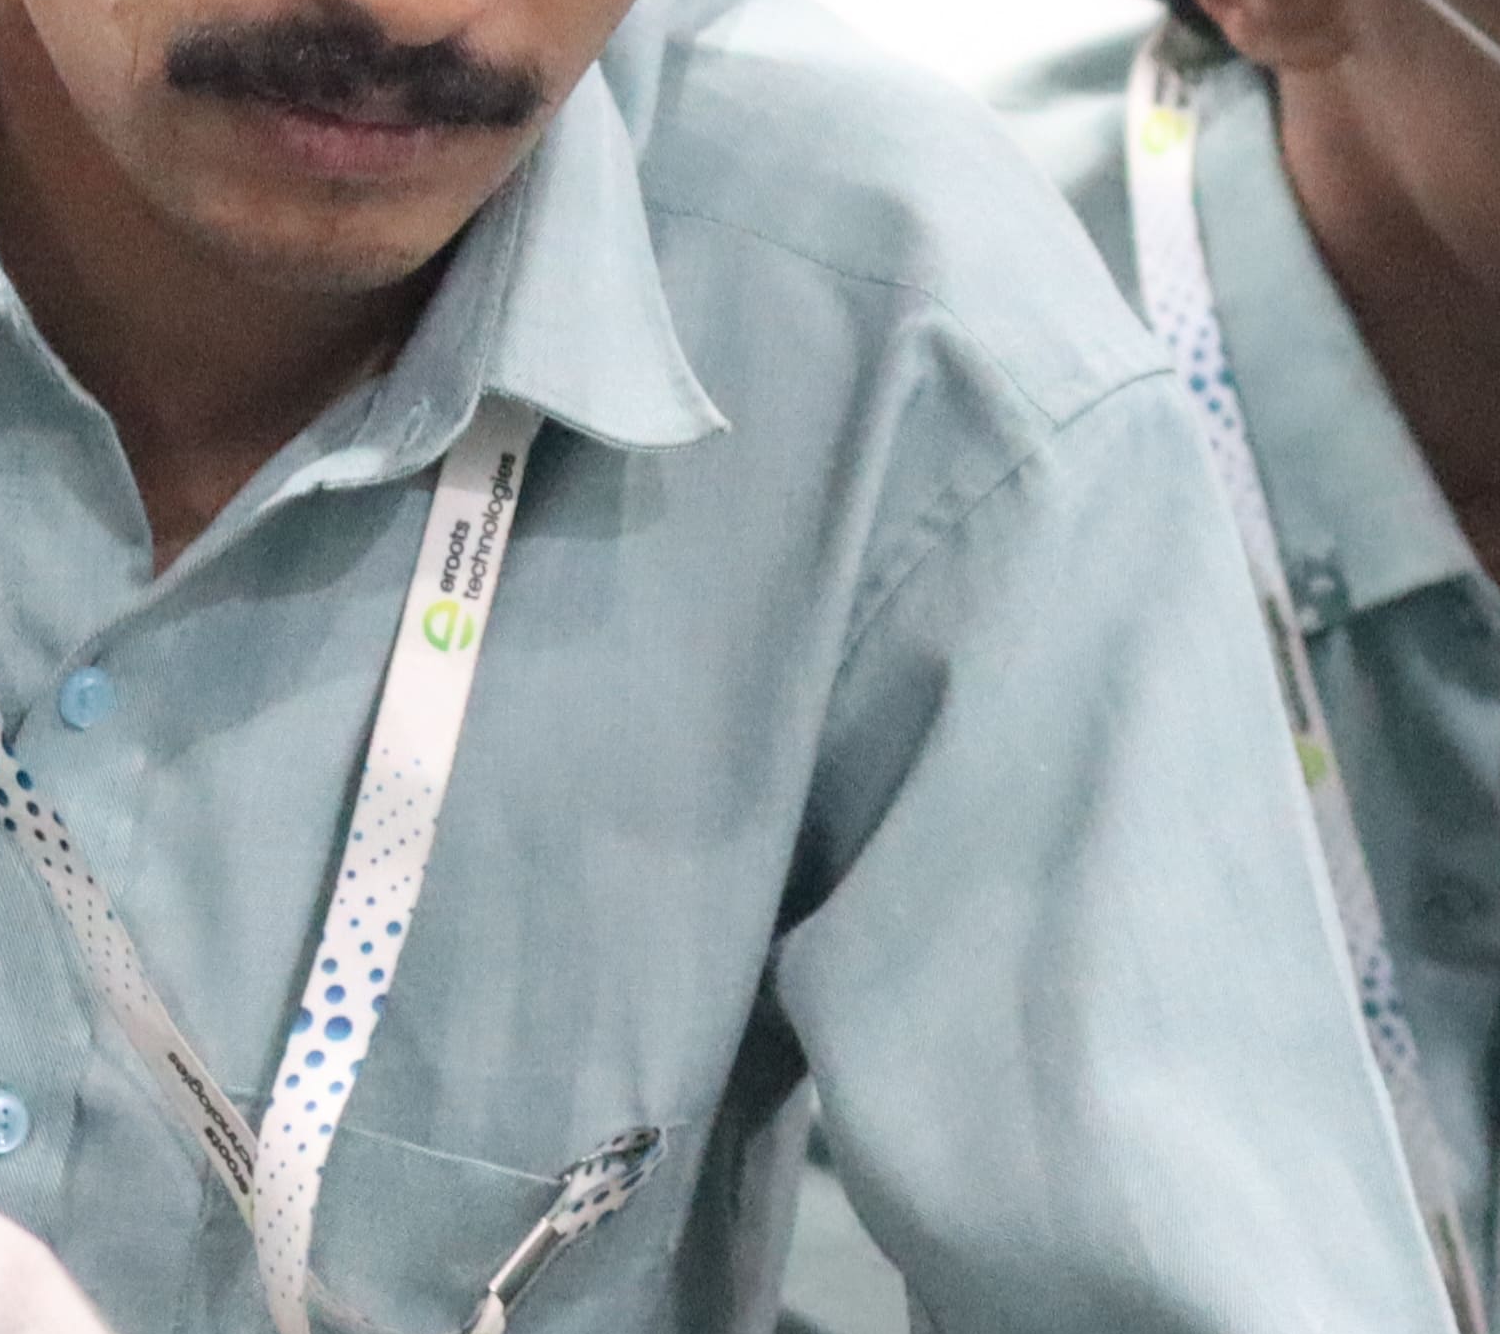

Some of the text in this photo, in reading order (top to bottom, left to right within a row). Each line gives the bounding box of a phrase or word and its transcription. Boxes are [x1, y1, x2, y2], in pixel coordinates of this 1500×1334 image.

[440, 520, 471, 593] eroots
[463, 452, 517, 601] technologies
[167, 1051, 254, 1179] chnologies
[204, 1126, 249, 1195] eroots
